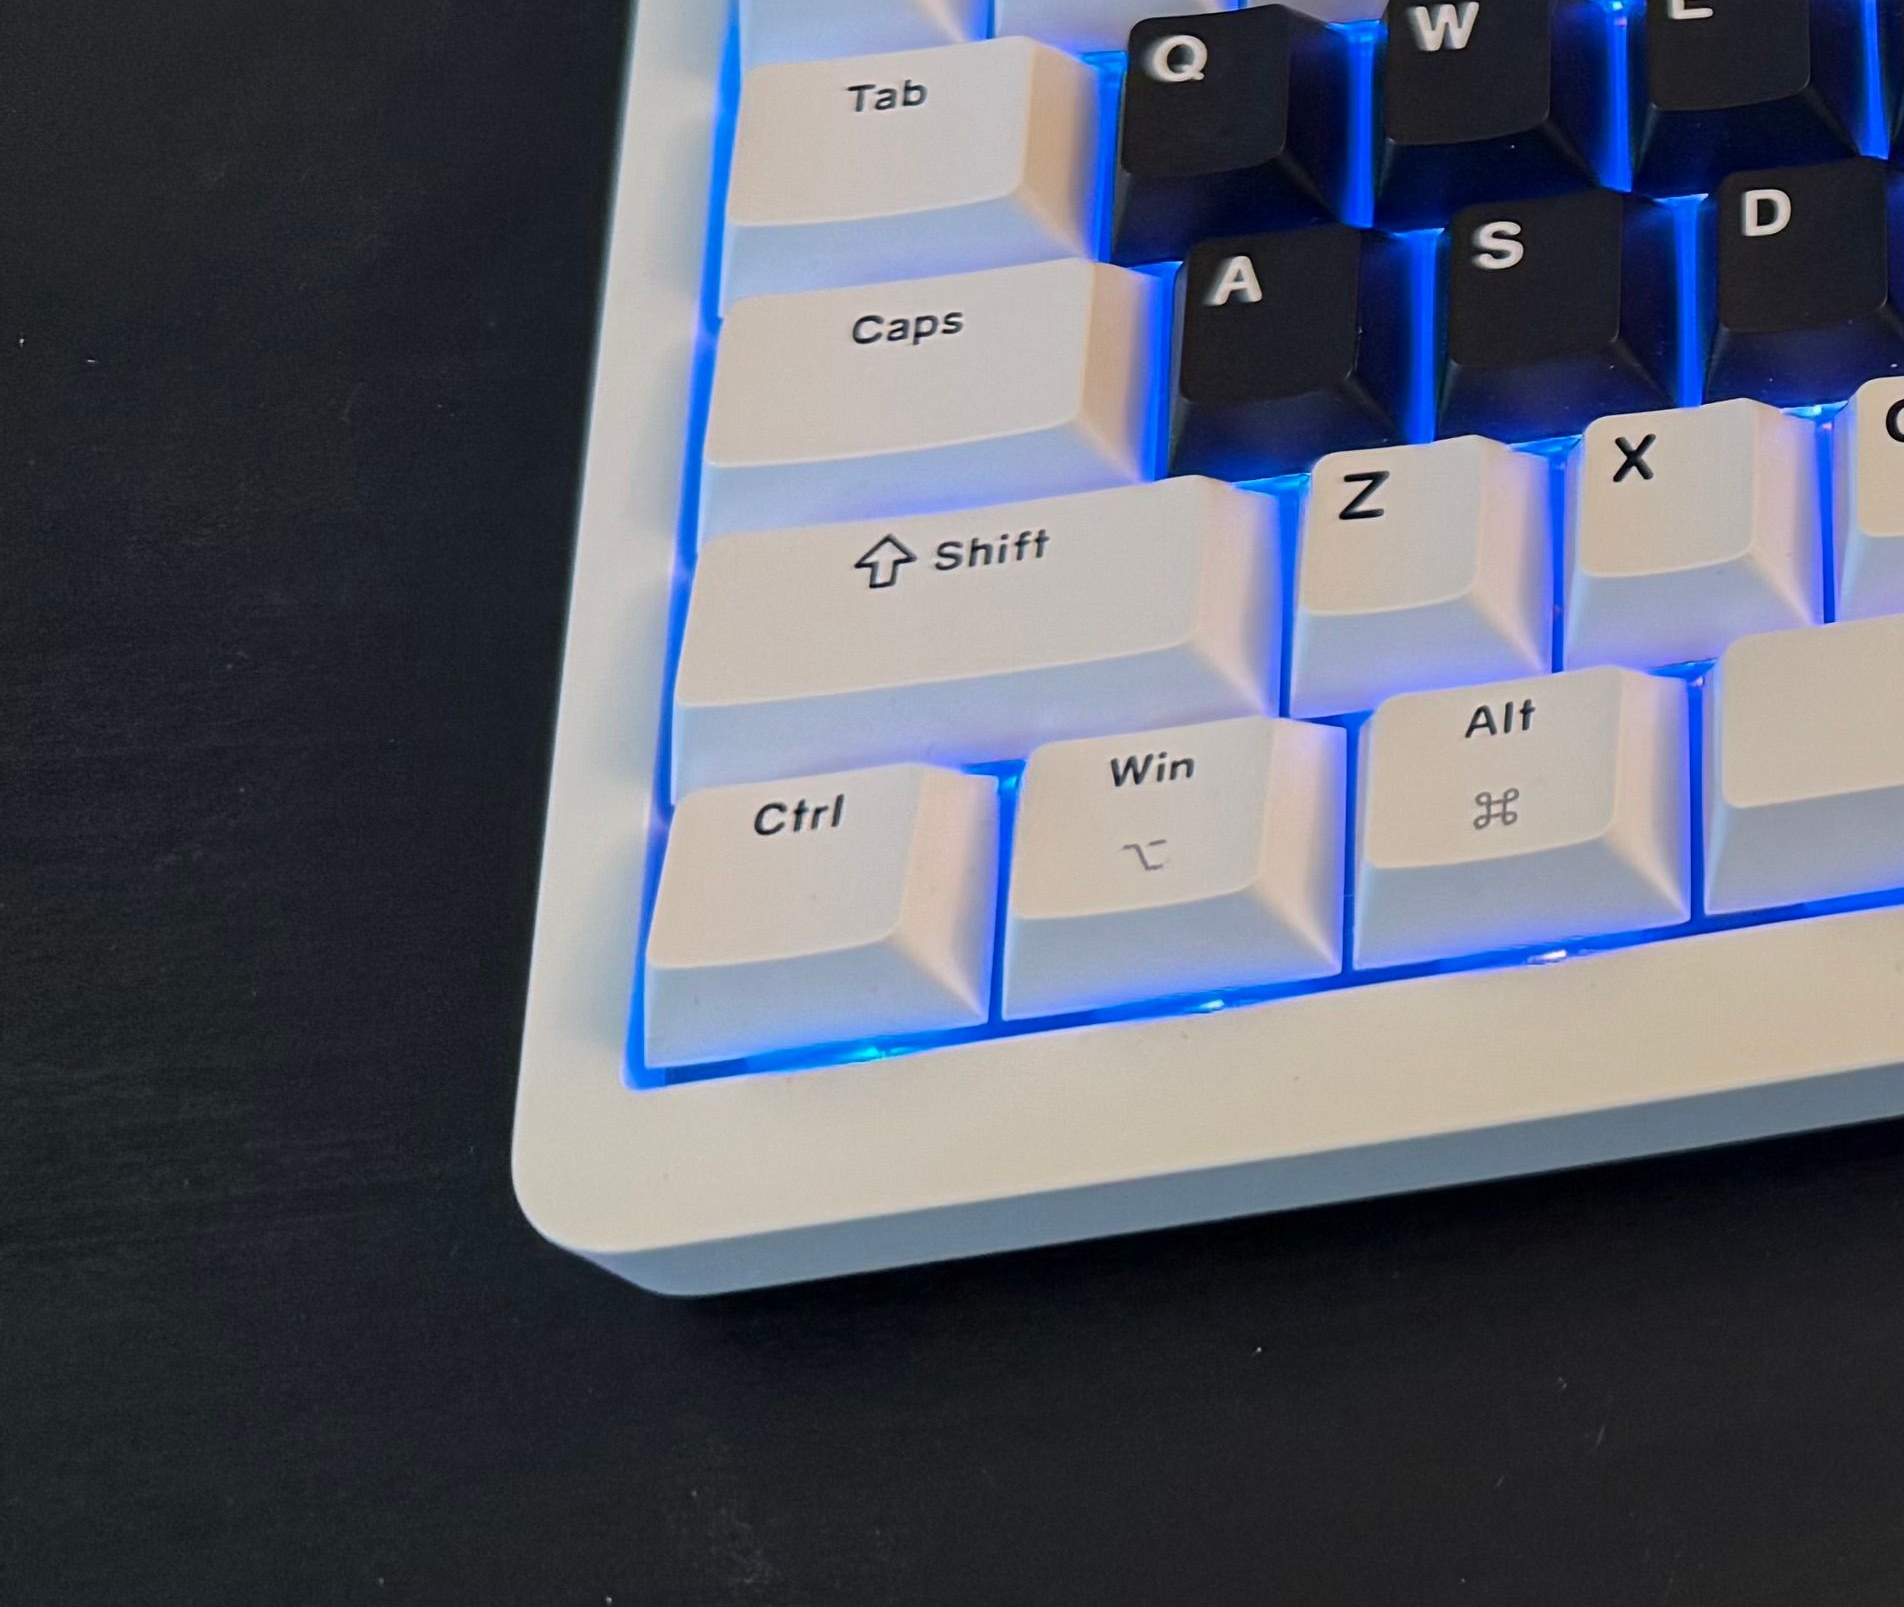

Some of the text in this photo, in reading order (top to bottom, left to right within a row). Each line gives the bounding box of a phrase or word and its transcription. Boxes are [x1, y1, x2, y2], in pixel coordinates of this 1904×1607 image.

[1410, 1, 1480, 52] W
[1147, 34, 1208, 83] Q
[846, 79, 927, 113] Tab
[1742, 188, 1792, 237] D
[1474, 221, 1524, 270] S
[1208, 255, 1263, 306] A
[851, 311, 963, 346] Caps
[1612, 433, 1656, 483] X
[1338, 470, 1389, 521] Z
[934, 529, 1049, 572] Shift
[1464, 699, 1535, 739] Alt
[1109, 751, 1194, 788] Win
[753, 794, 845, 837] Ctrl
